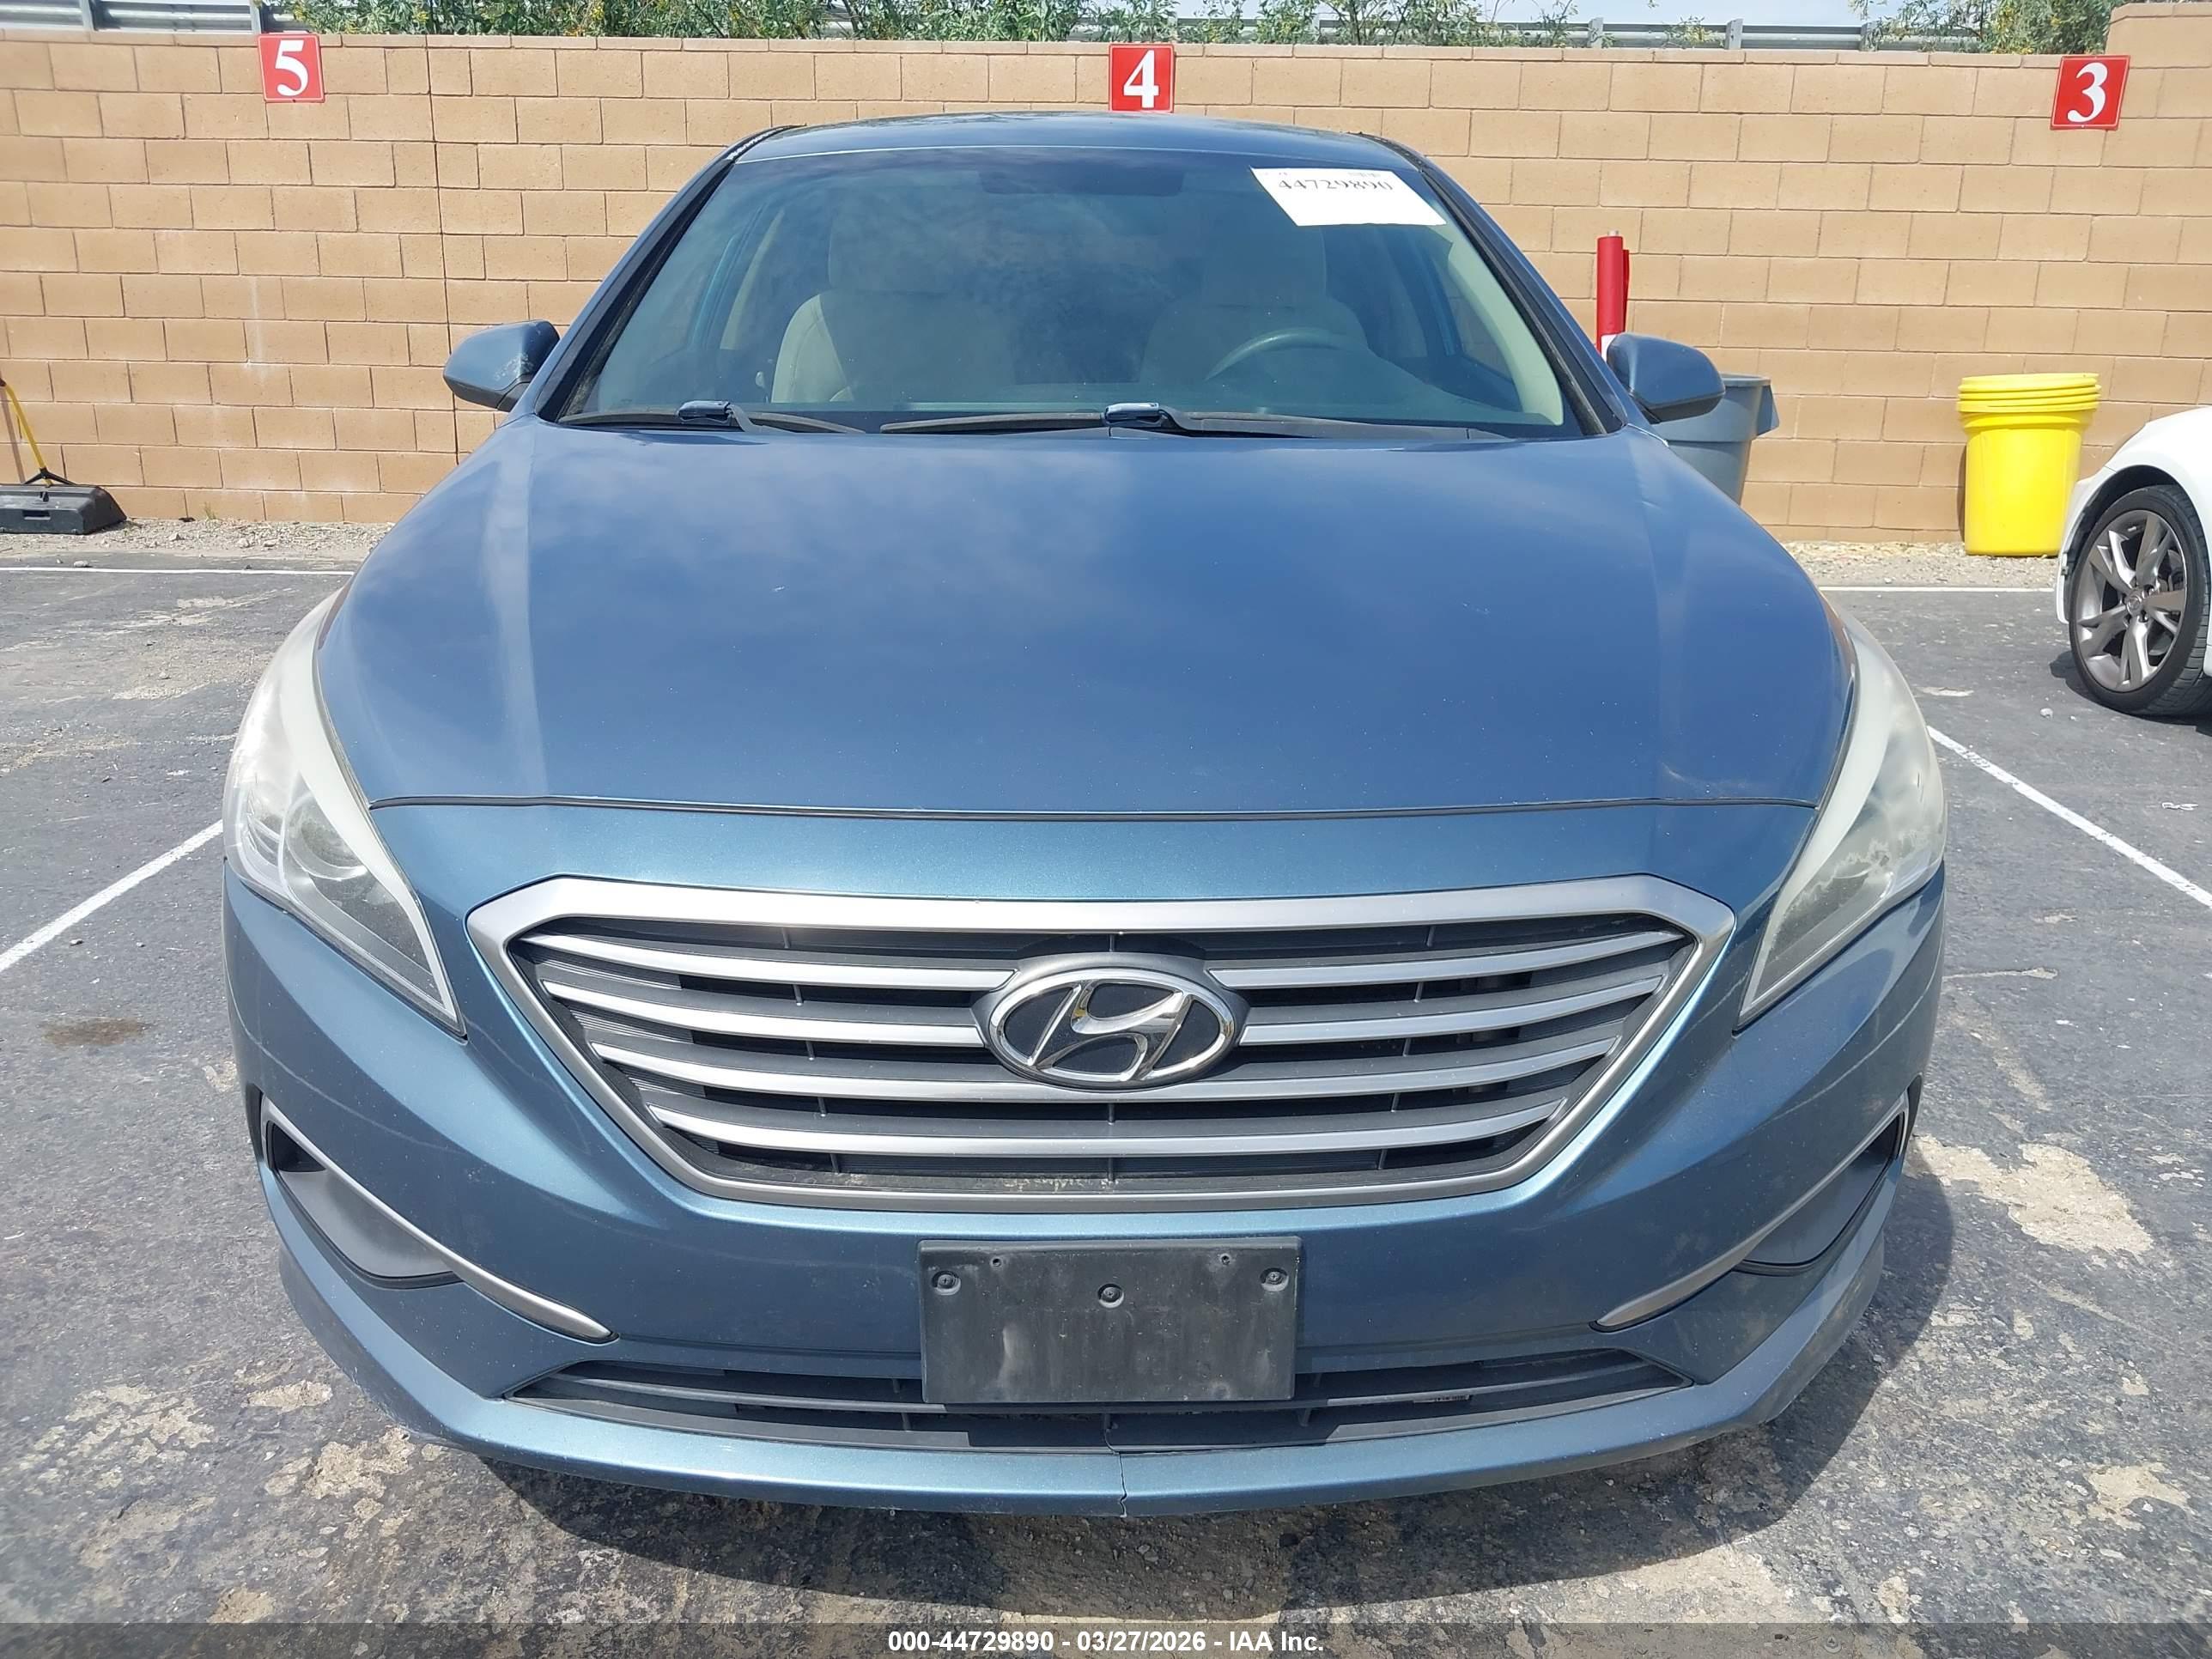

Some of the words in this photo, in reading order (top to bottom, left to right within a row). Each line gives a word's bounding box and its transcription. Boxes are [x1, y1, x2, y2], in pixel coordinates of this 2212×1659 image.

[275, 40, 309, 96] 5
[1123, 49, 1159, 108] 4
[2067, 62, 2108, 123] 3
[1277, 179, 1394, 191] 44729890
